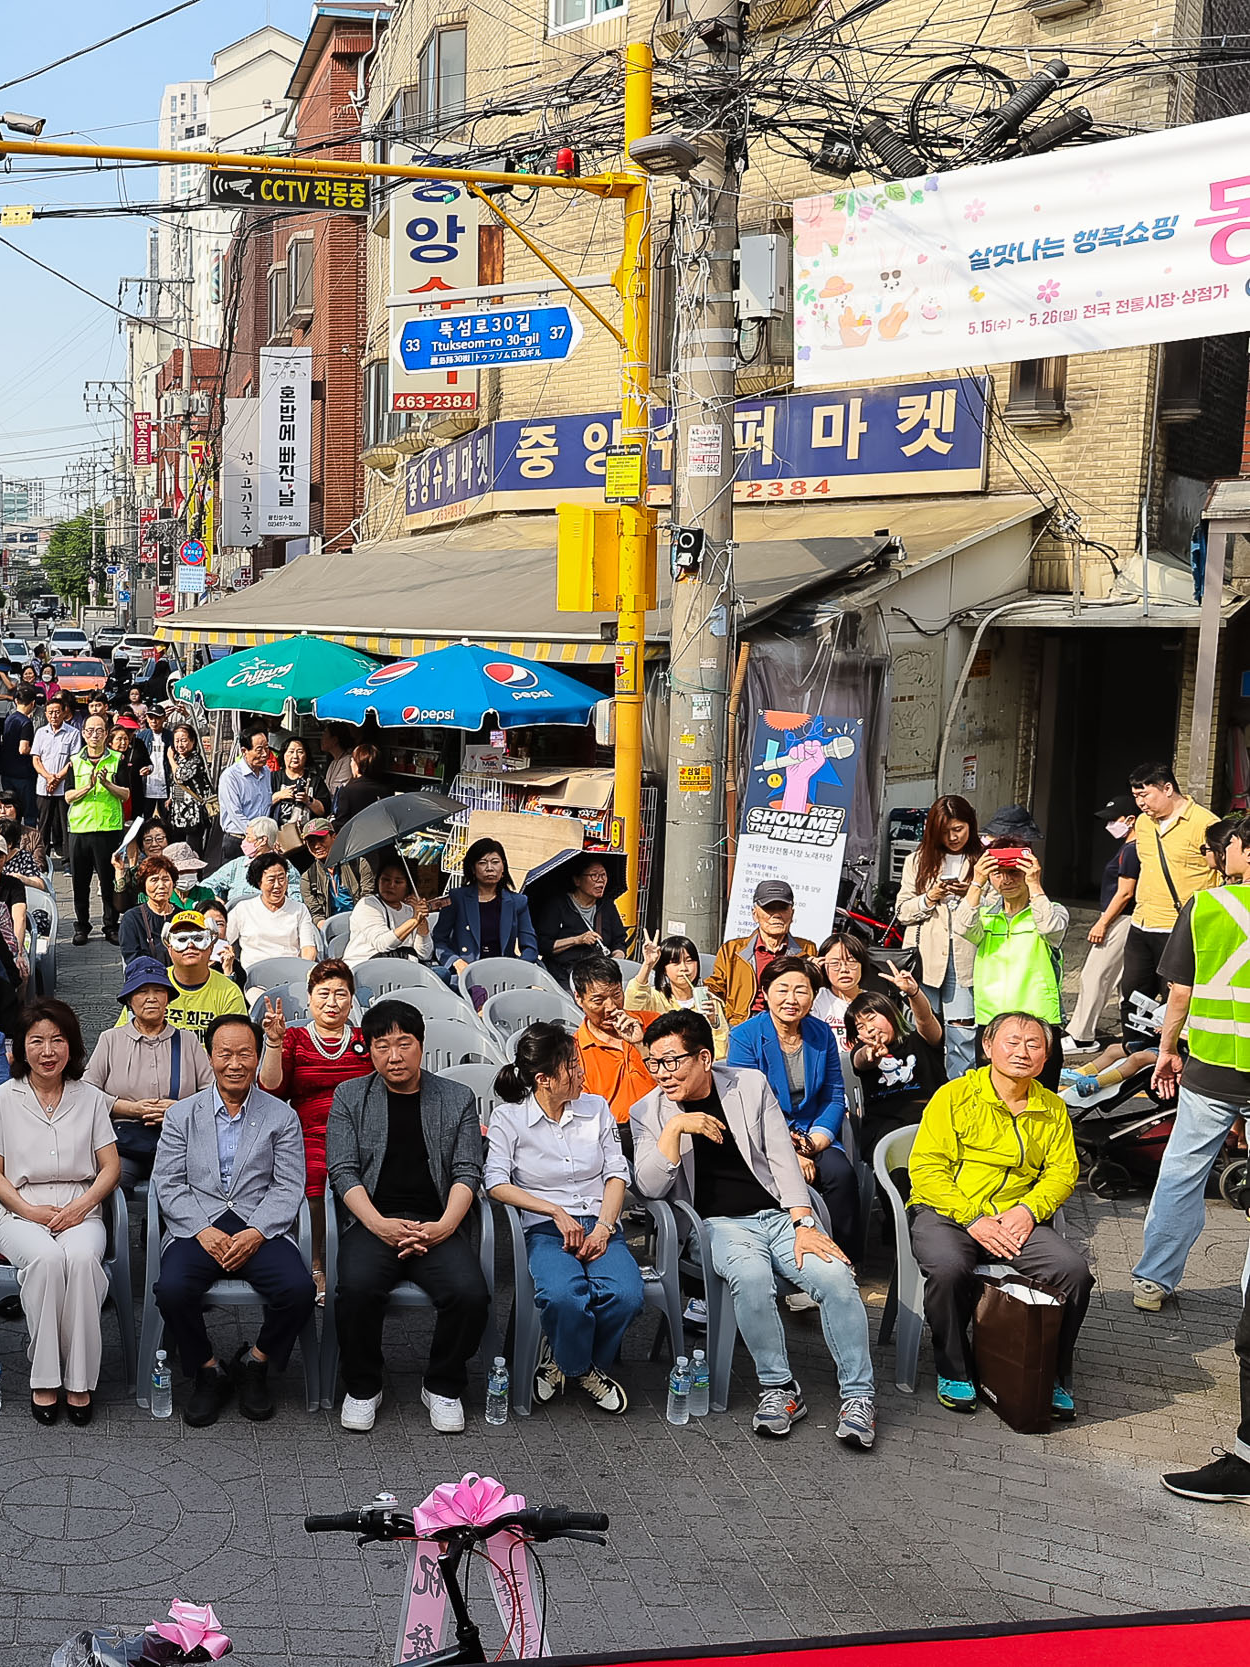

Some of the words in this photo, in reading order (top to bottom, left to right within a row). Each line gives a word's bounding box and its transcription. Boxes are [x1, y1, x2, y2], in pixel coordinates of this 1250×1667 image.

[260, 178, 310, 203] CCTV
[313, 180, 366, 208] 작동중
[968, 236, 1066, 272] 살맛나는
[1072, 214, 1179, 254] 행복쇼핑
[968, 319, 1011, 335] 5.15(수)
[1029, 308, 1078, 327] 5.26(일)
[1083, 302, 1111, 319] 전국
[1115, 283, 1230, 314] 전통시장·상점가
[430, 338, 503, 353] Ttukseom-ro
[506, 332, 540, 347] 30-gil
[549, 326, 567, 340] 37
[405, 339, 421, 352] 33
[396, 395, 472, 410] 463-2384
[279, 386, 296, 441] 혼밥에
[279, 446, 296, 483] 빠진
[408, 433, 489, 508] 중앙슈퍼마켓
[279, 489, 296, 507] 날
[511, 689, 554, 701] pepsi
[420, 709, 455, 722] pepsi
[749, 809, 809, 828] SHOW
[806, 817, 841, 832] ME
[810, 807, 843, 819] 2024
[749, 822, 772, 833] THE
